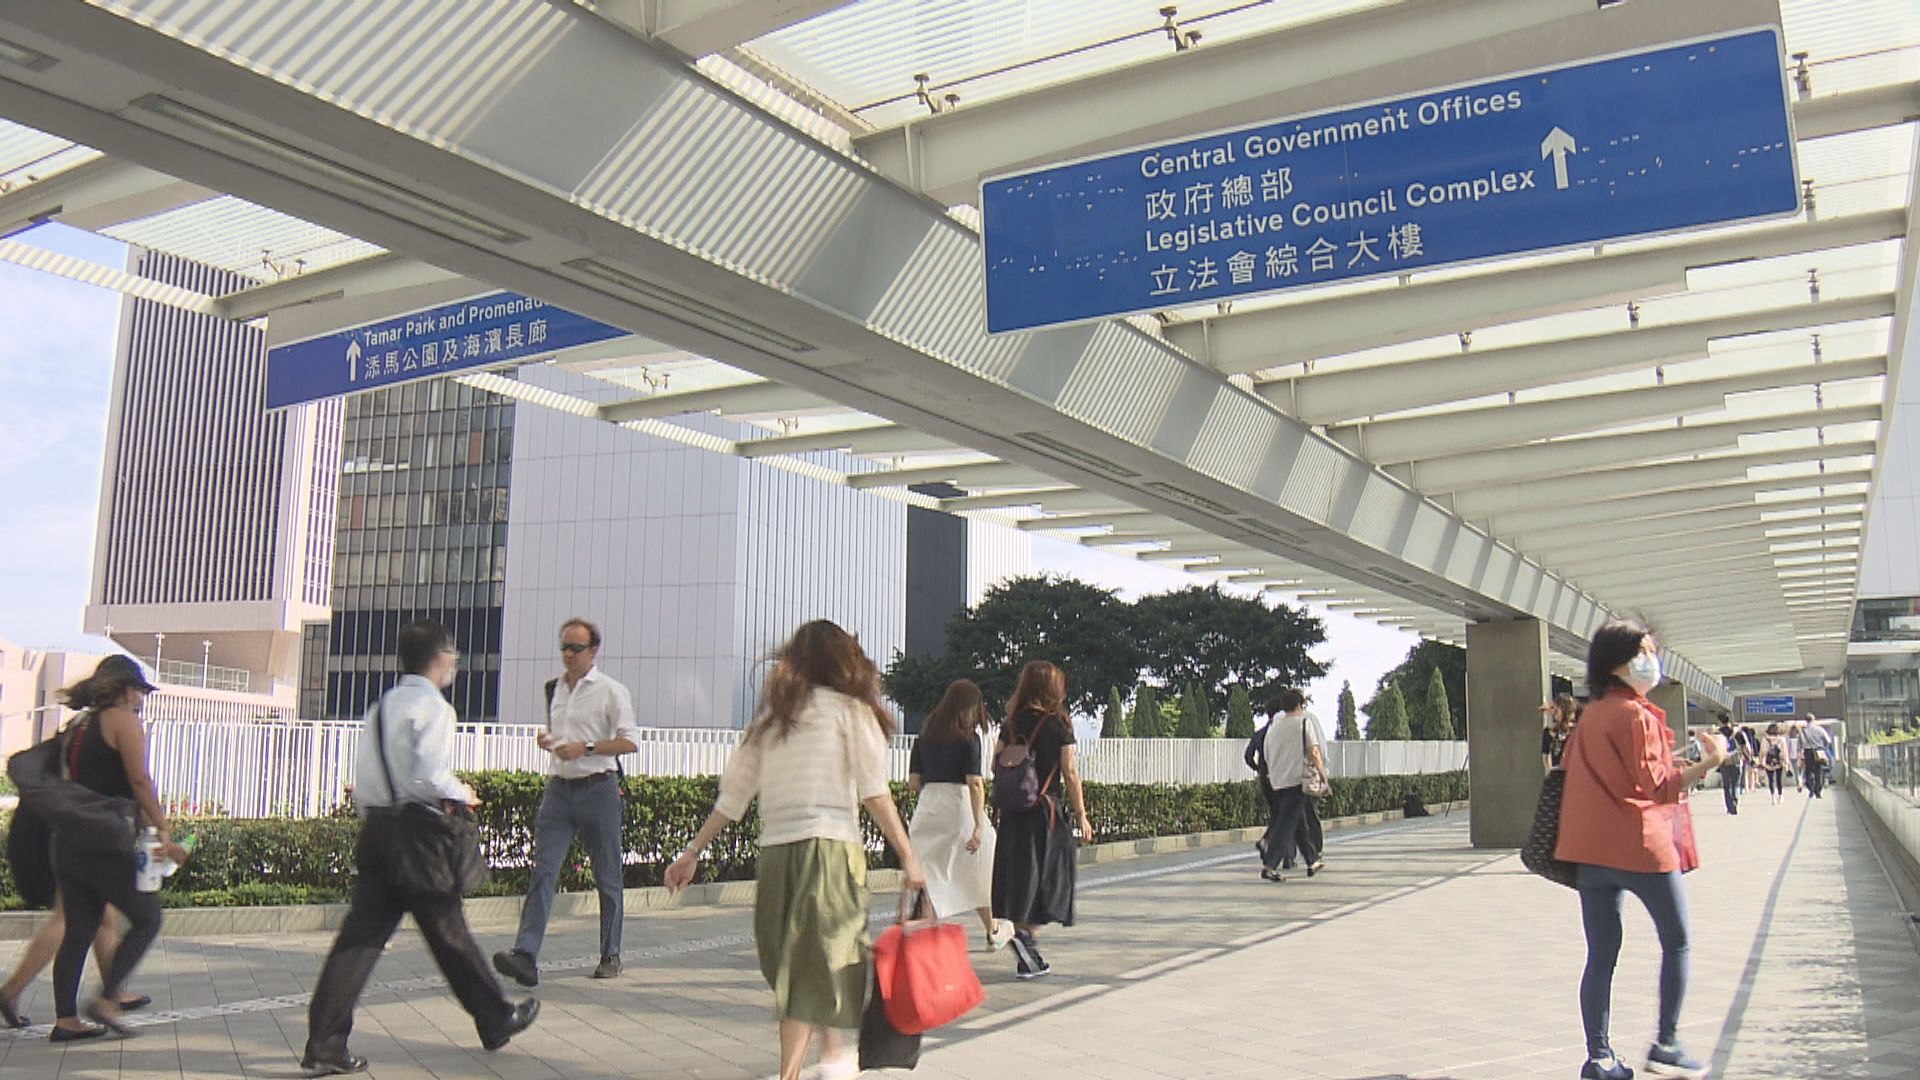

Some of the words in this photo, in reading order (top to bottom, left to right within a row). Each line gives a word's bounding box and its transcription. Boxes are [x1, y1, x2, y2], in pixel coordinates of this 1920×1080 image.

[1141, 141, 1236, 178] Central
[1245, 108, 1409, 159] Government
[1418, 90, 1522, 125] Offices
[1145, 167, 1293, 221] 政府總部
[1146, 213, 1283, 252] Legislative
[1292, 188, 1397, 226] Council
[1406, 170, 1536, 207] Complex
[1150, 222, 1424, 296] 立法會綜合大樓
[364, 328, 402, 347] Tamar
[406, 318, 435, 338] Park
[439, 309, 465, 329] and
[469, 297, 548, 324] Promenad
[364, 319, 548, 379] 添馬公園及海濱長廊
